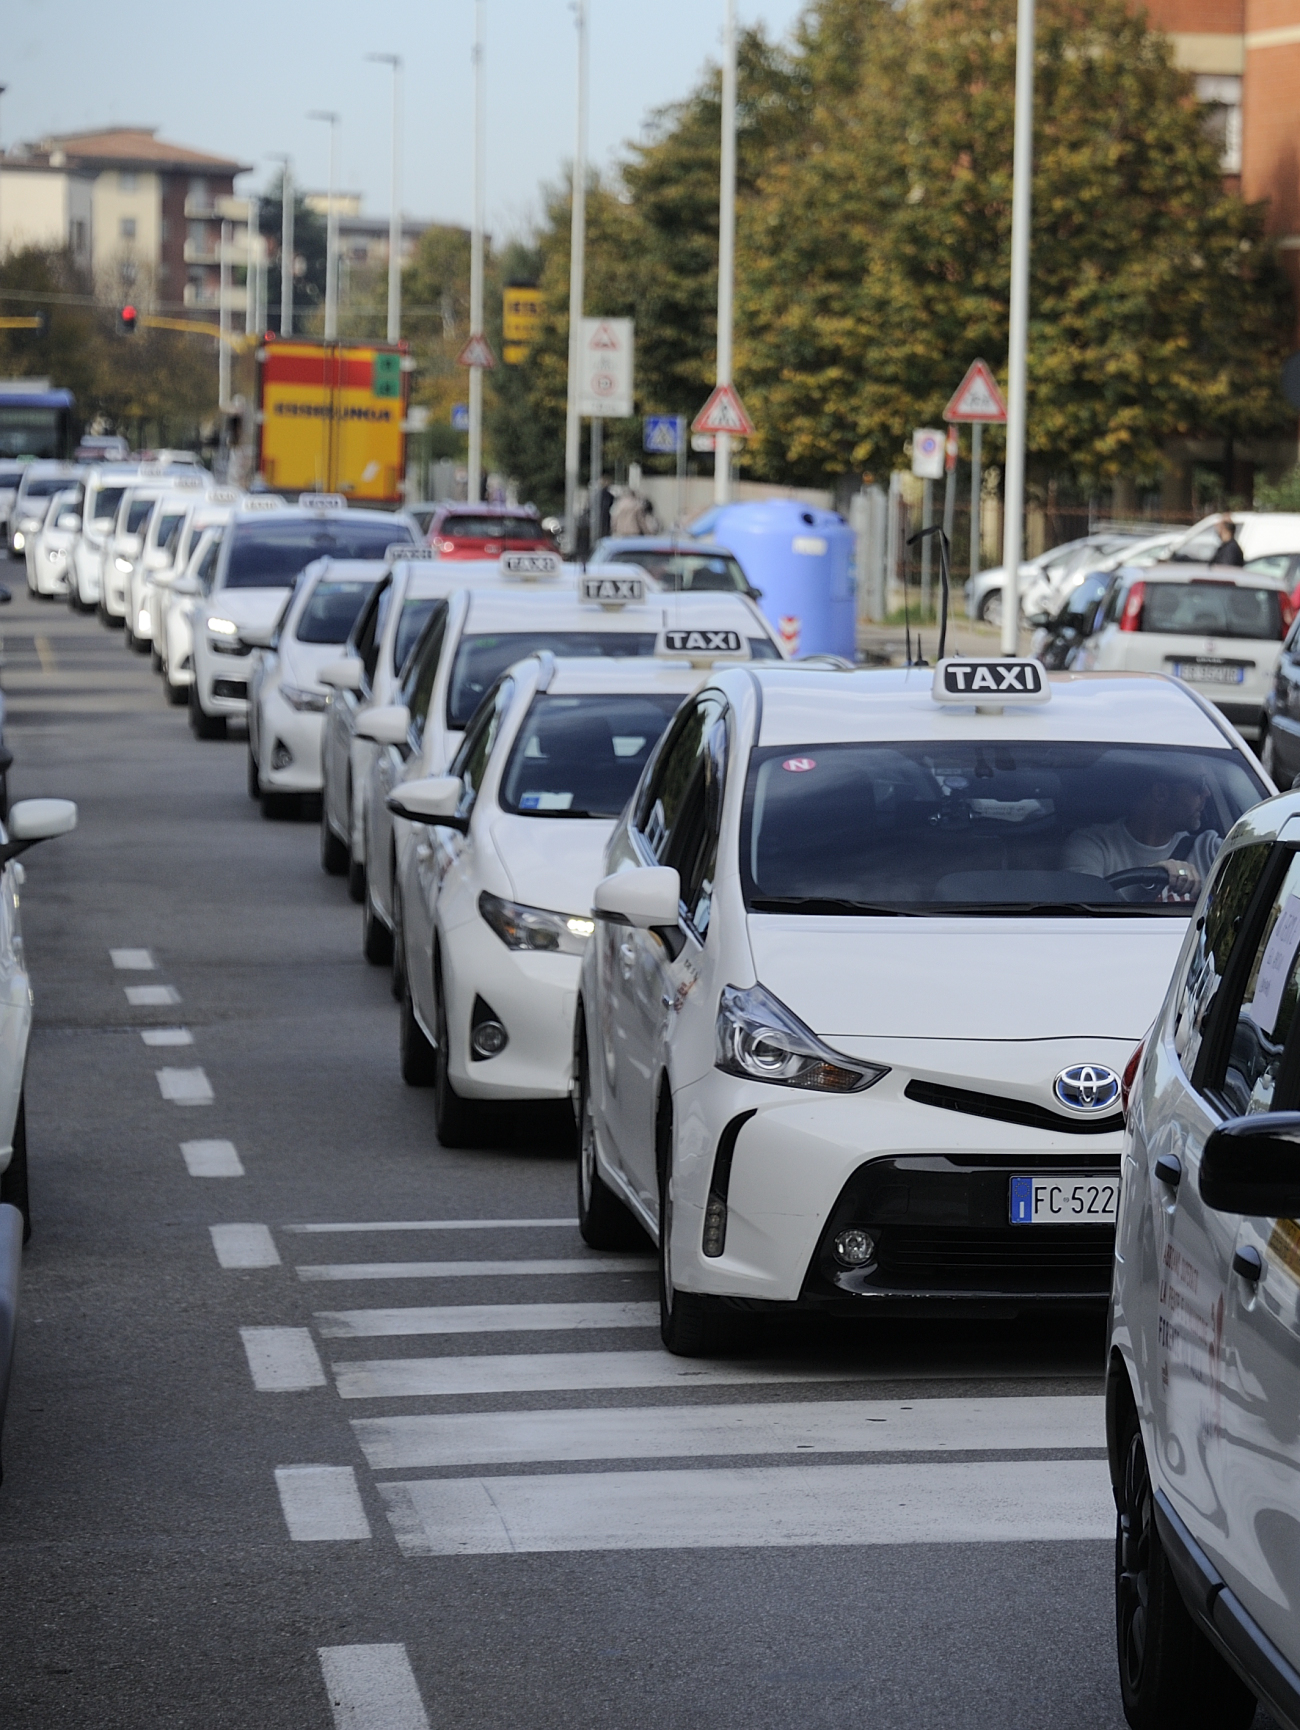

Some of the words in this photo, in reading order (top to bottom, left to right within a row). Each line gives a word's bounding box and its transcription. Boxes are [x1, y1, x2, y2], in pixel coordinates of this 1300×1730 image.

[509, 557, 555, 571] TAXI
[586, 581, 642, 599] TAXI
[669, 631, 739, 650] TAXI
[946, 666, 1035, 690] TAXI
[788, 758, 810, 771] N
